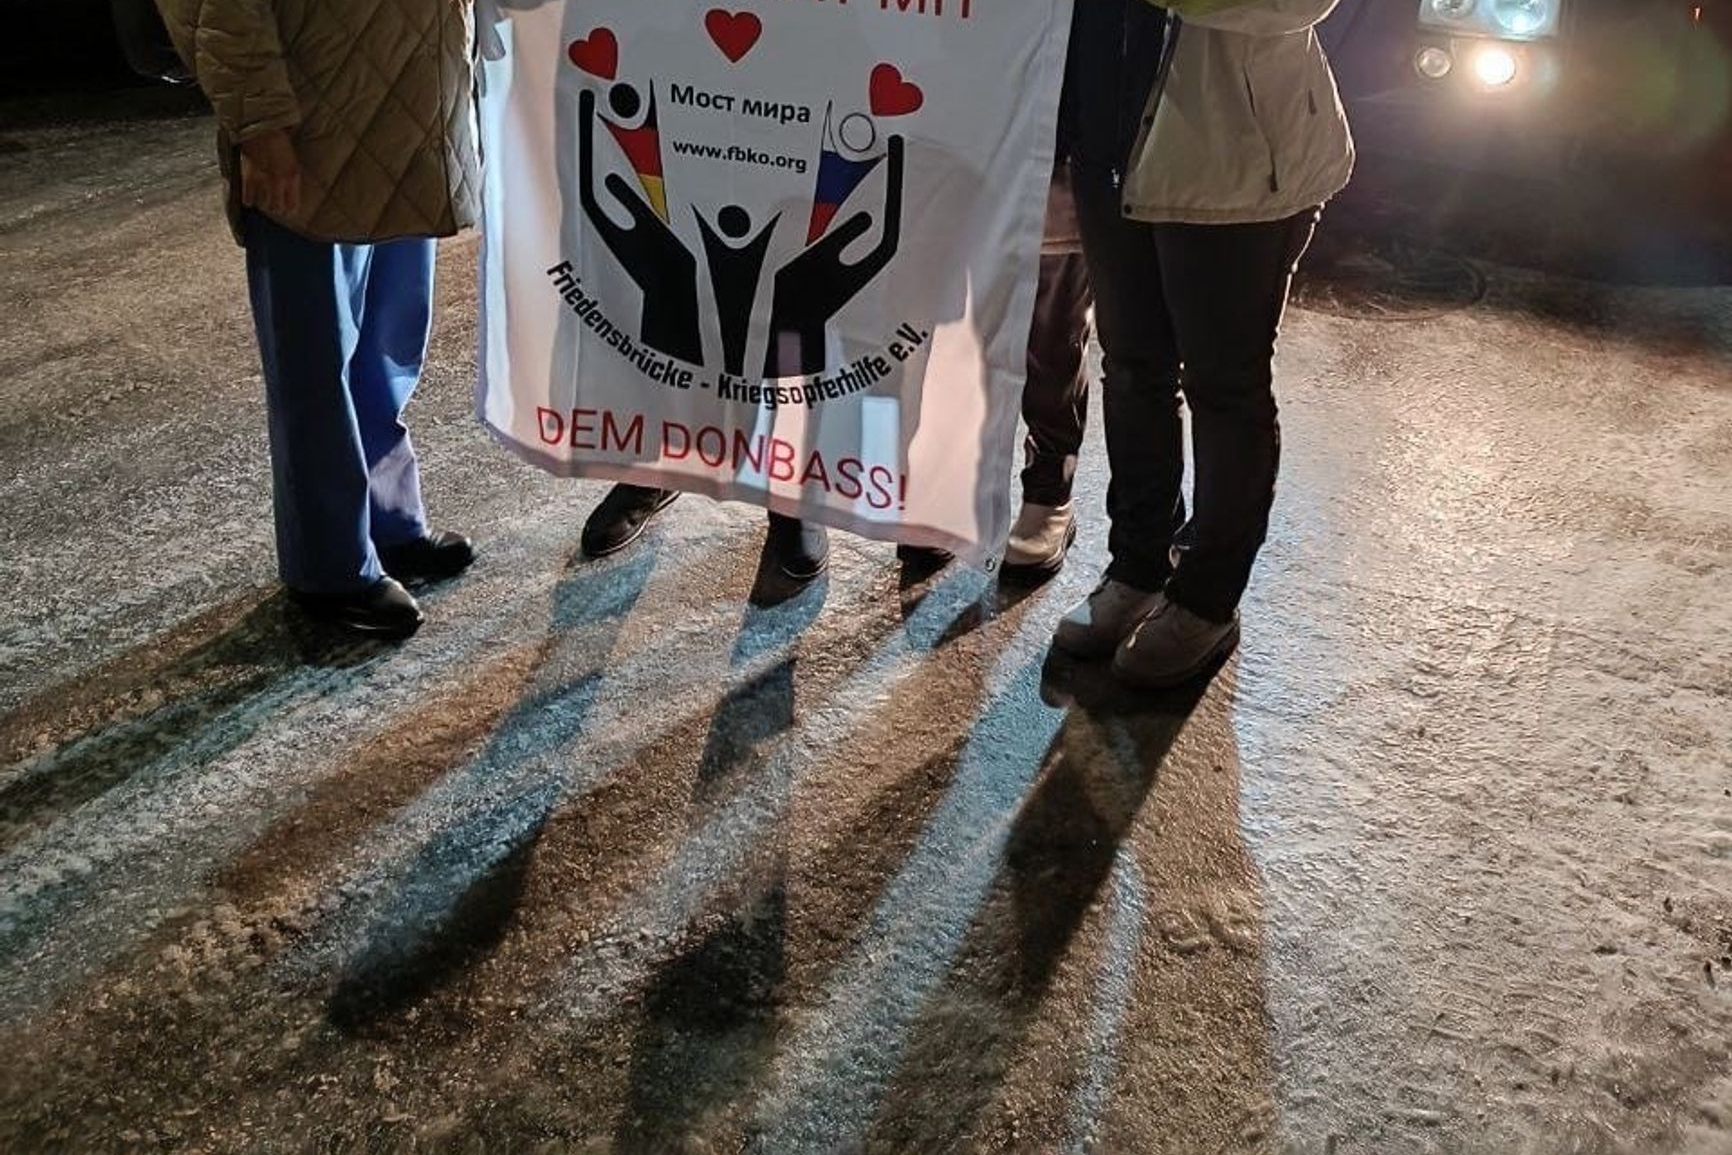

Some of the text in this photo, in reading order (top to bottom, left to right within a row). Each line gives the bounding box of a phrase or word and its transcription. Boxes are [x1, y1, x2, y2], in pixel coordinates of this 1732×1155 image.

[670, 83, 811, 126] Мост мира
[672, 140, 808, 174] www.fbko.org
[547, 260, 695, 390] Friedensbrücke
[717, 352, 893, 411] Kriegsopferhilfe
[888, 321, 929, 362] e.V.
[535, 406, 908, 511] DEM DONBASS!
